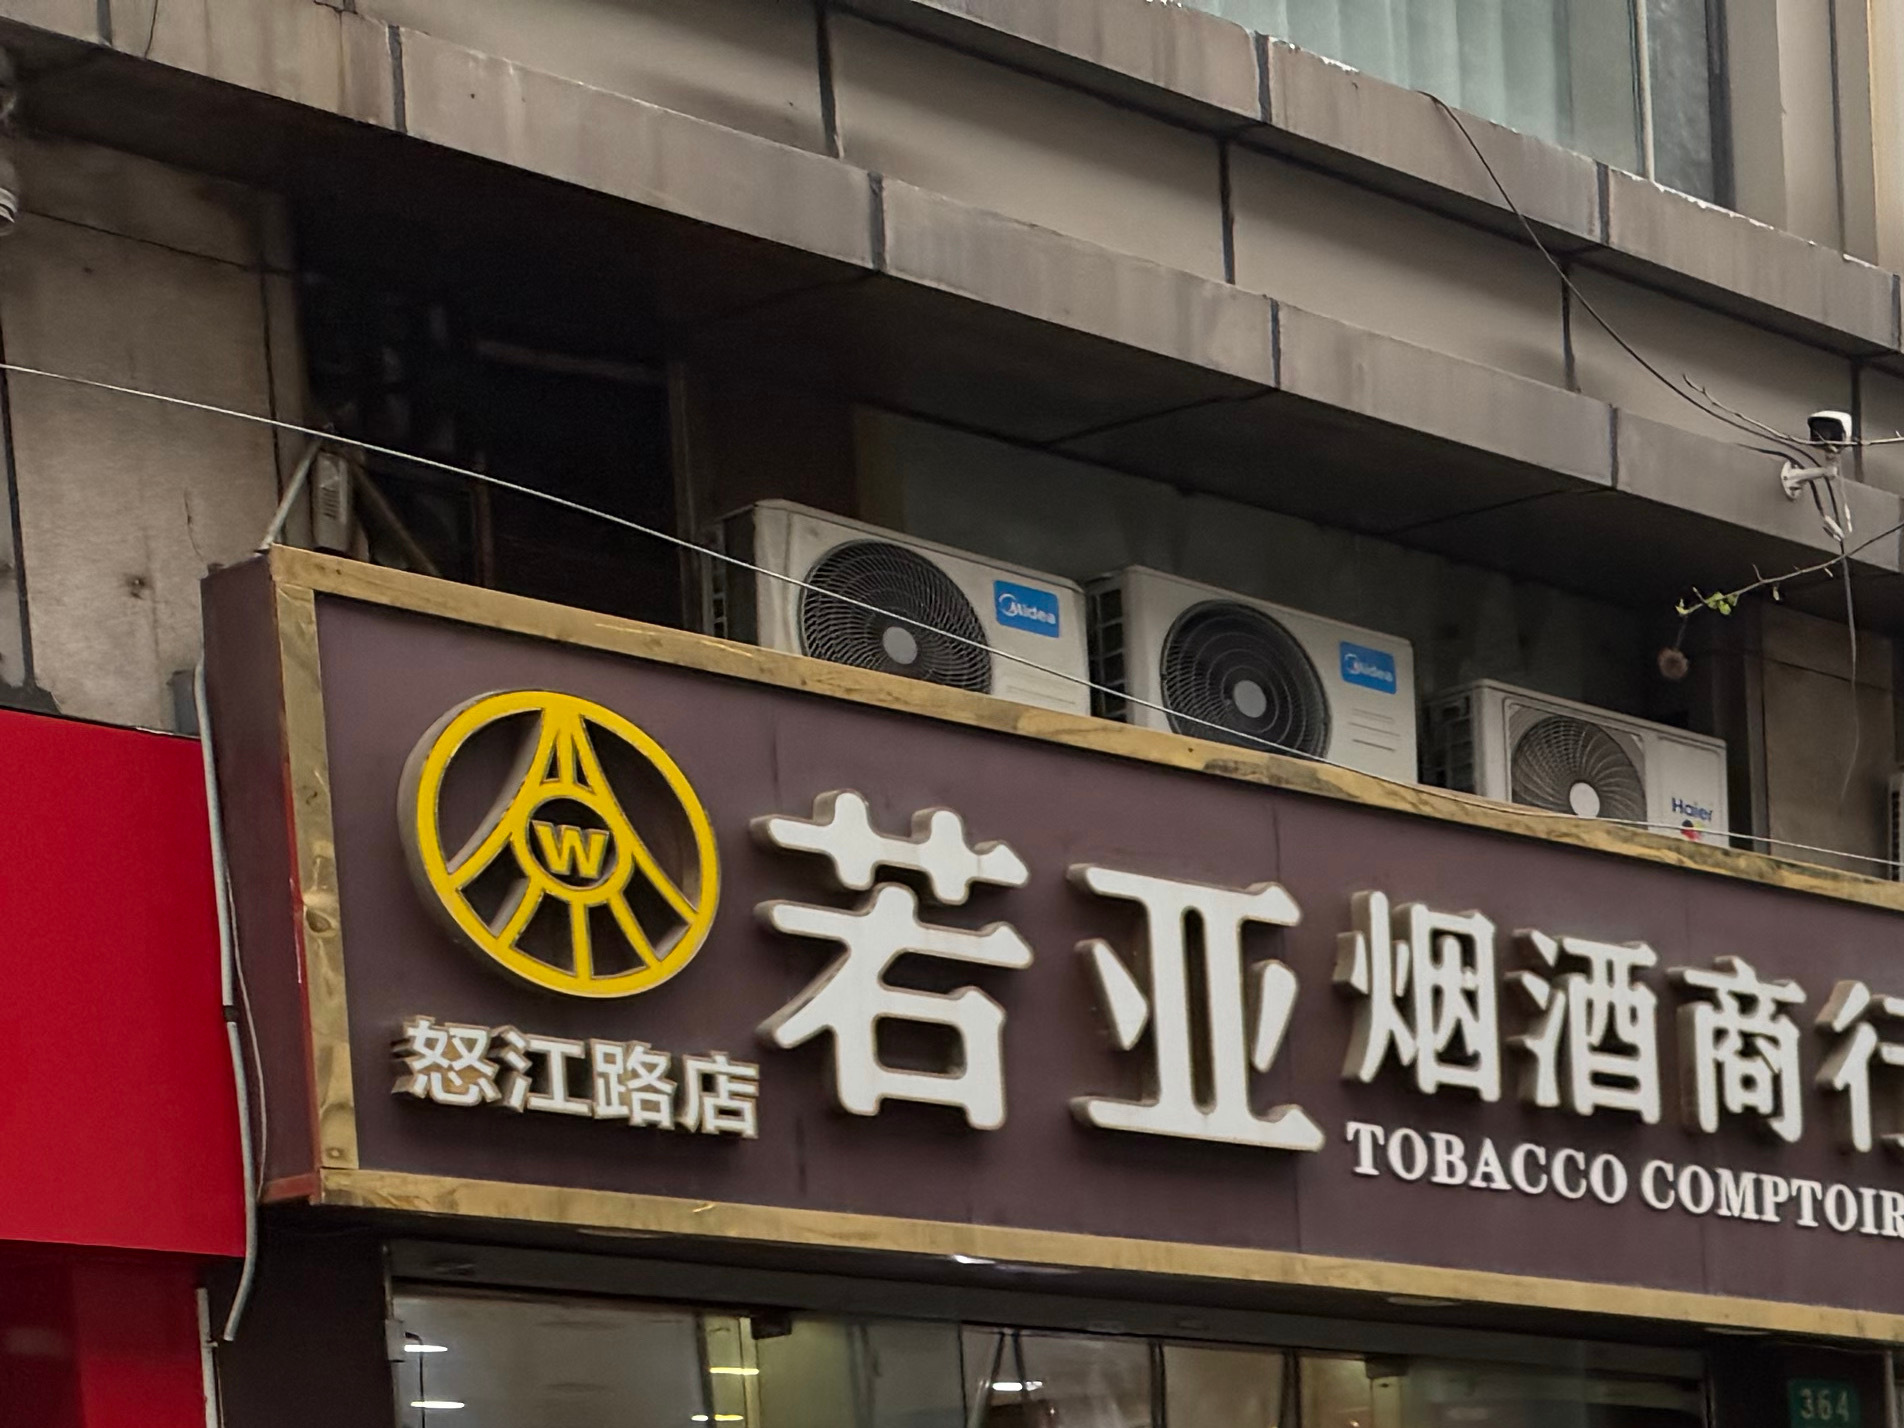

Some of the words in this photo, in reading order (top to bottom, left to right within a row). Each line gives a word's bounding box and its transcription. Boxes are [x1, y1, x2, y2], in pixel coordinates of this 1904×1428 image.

[998, 593, 1057, 627] Midea
[1671, 797, 1712, 822] Haier
[532, 820, 608, 879] W
[400, 1016, 759, 1138] 怒江路店
[1346, 1121, 1629, 1204] TOBACCO
[1800, 1387, 1850, 1423] 364
